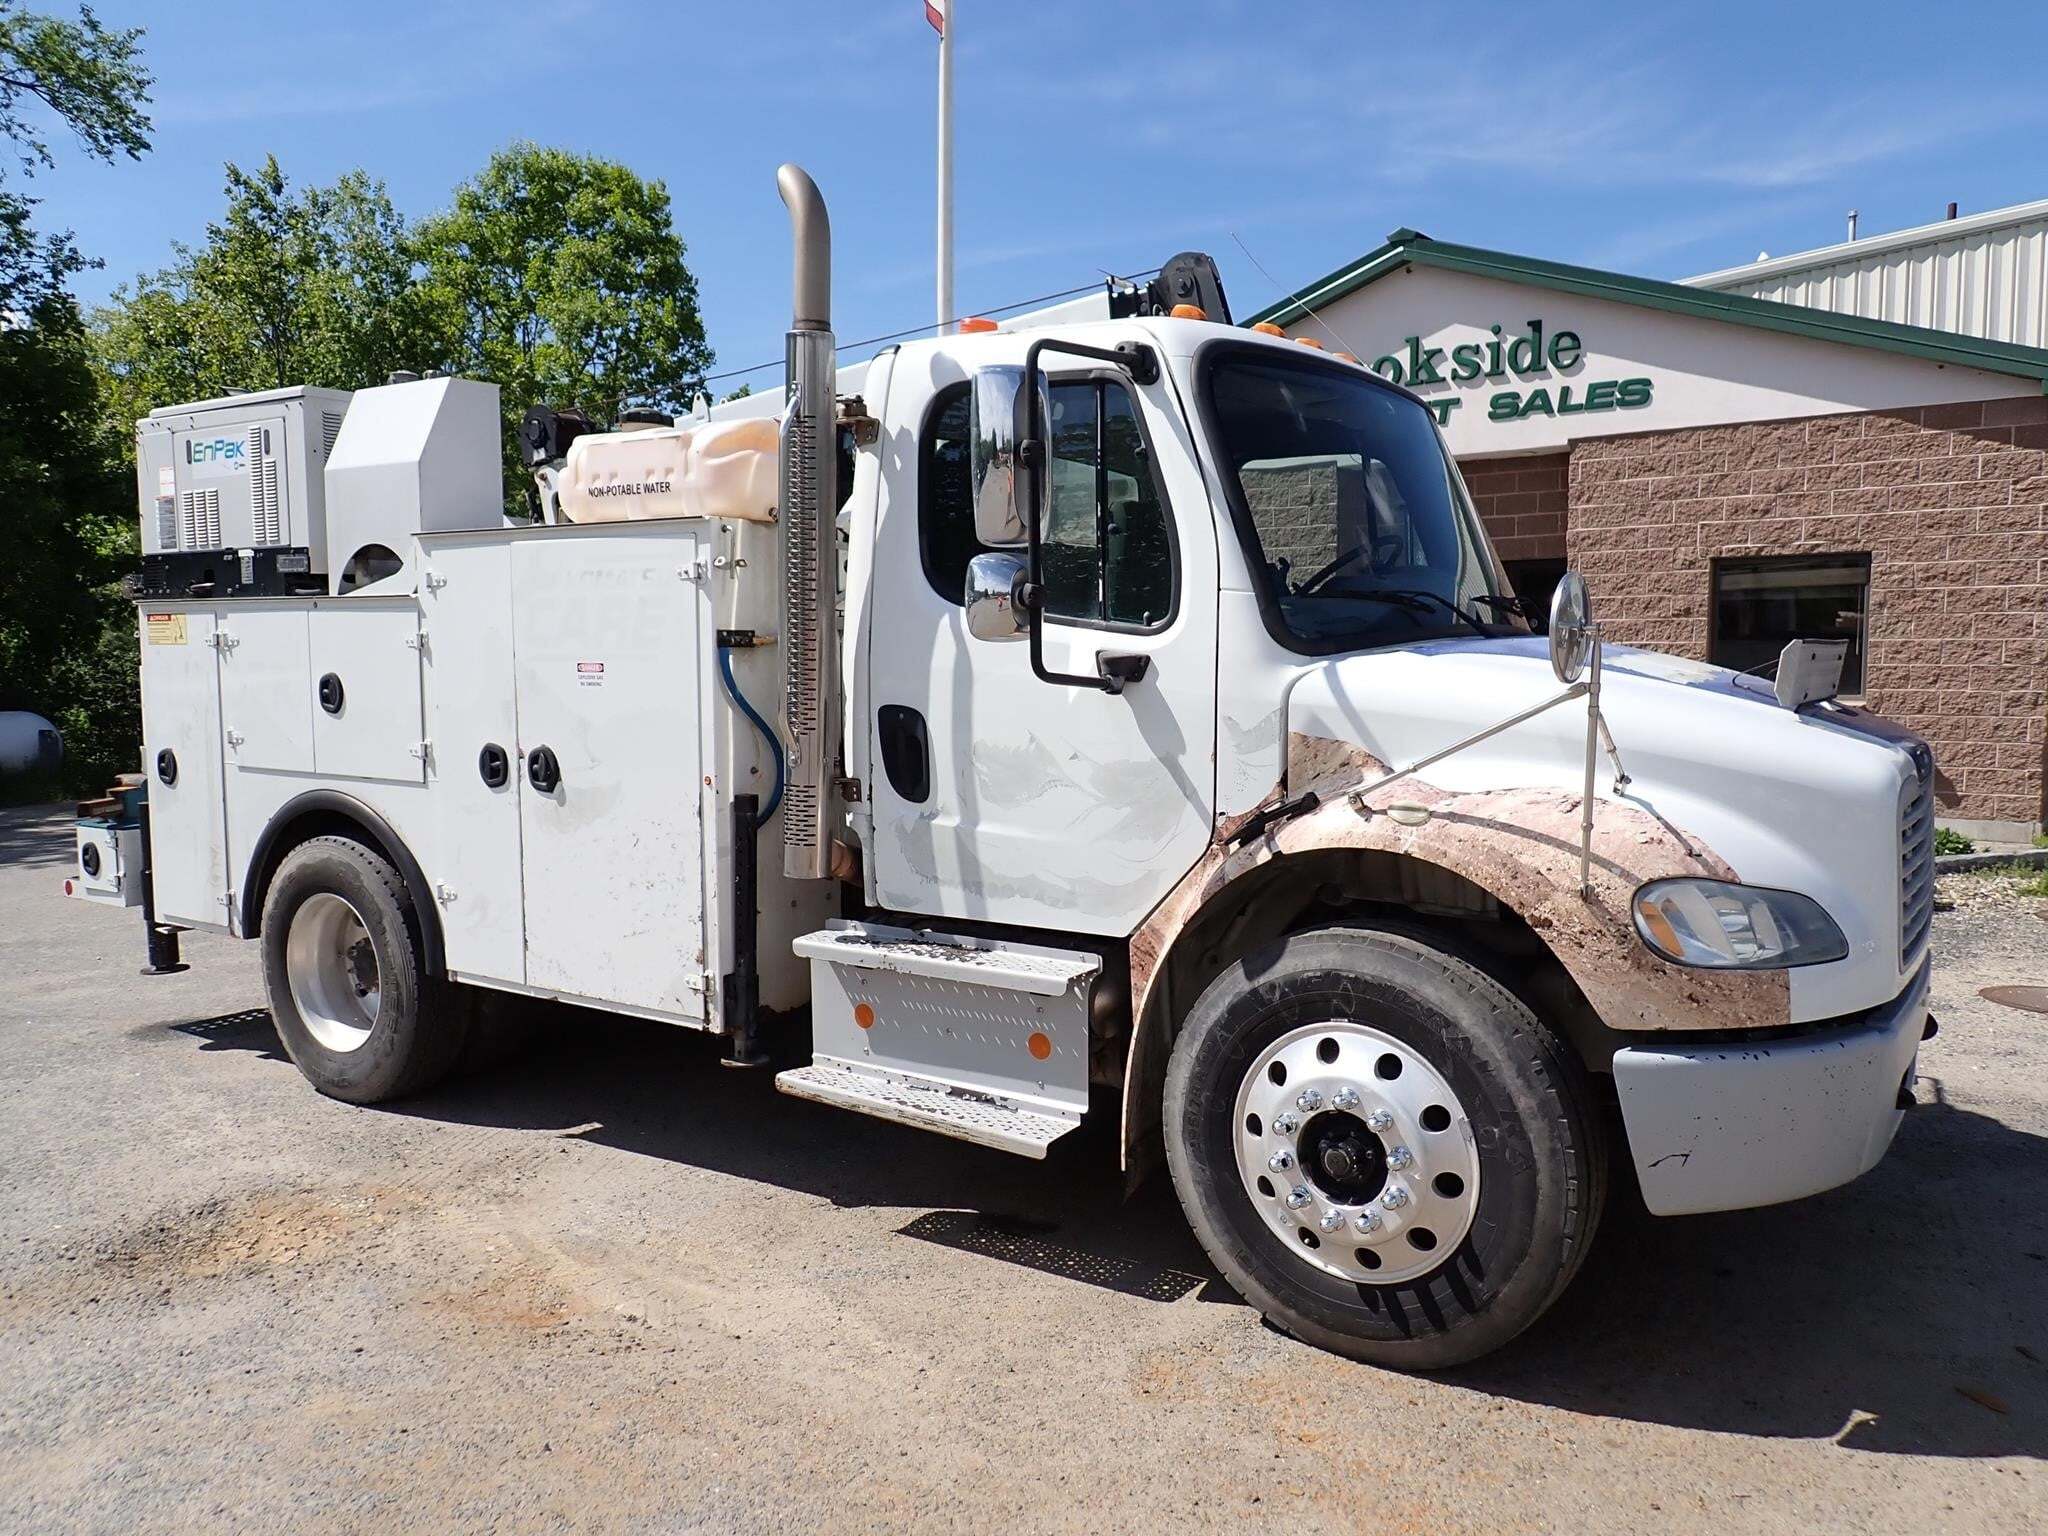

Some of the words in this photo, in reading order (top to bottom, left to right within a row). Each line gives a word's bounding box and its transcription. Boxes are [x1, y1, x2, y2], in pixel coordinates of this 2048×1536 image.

[1426, 397, 1461, 425] T
[1487, 378, 1653, 420] SALES
[193, 440, 245, 462] EnPak
[588, 483, 641, 498] NON-POTABLE
[643, 481, 671, 494] WATER
